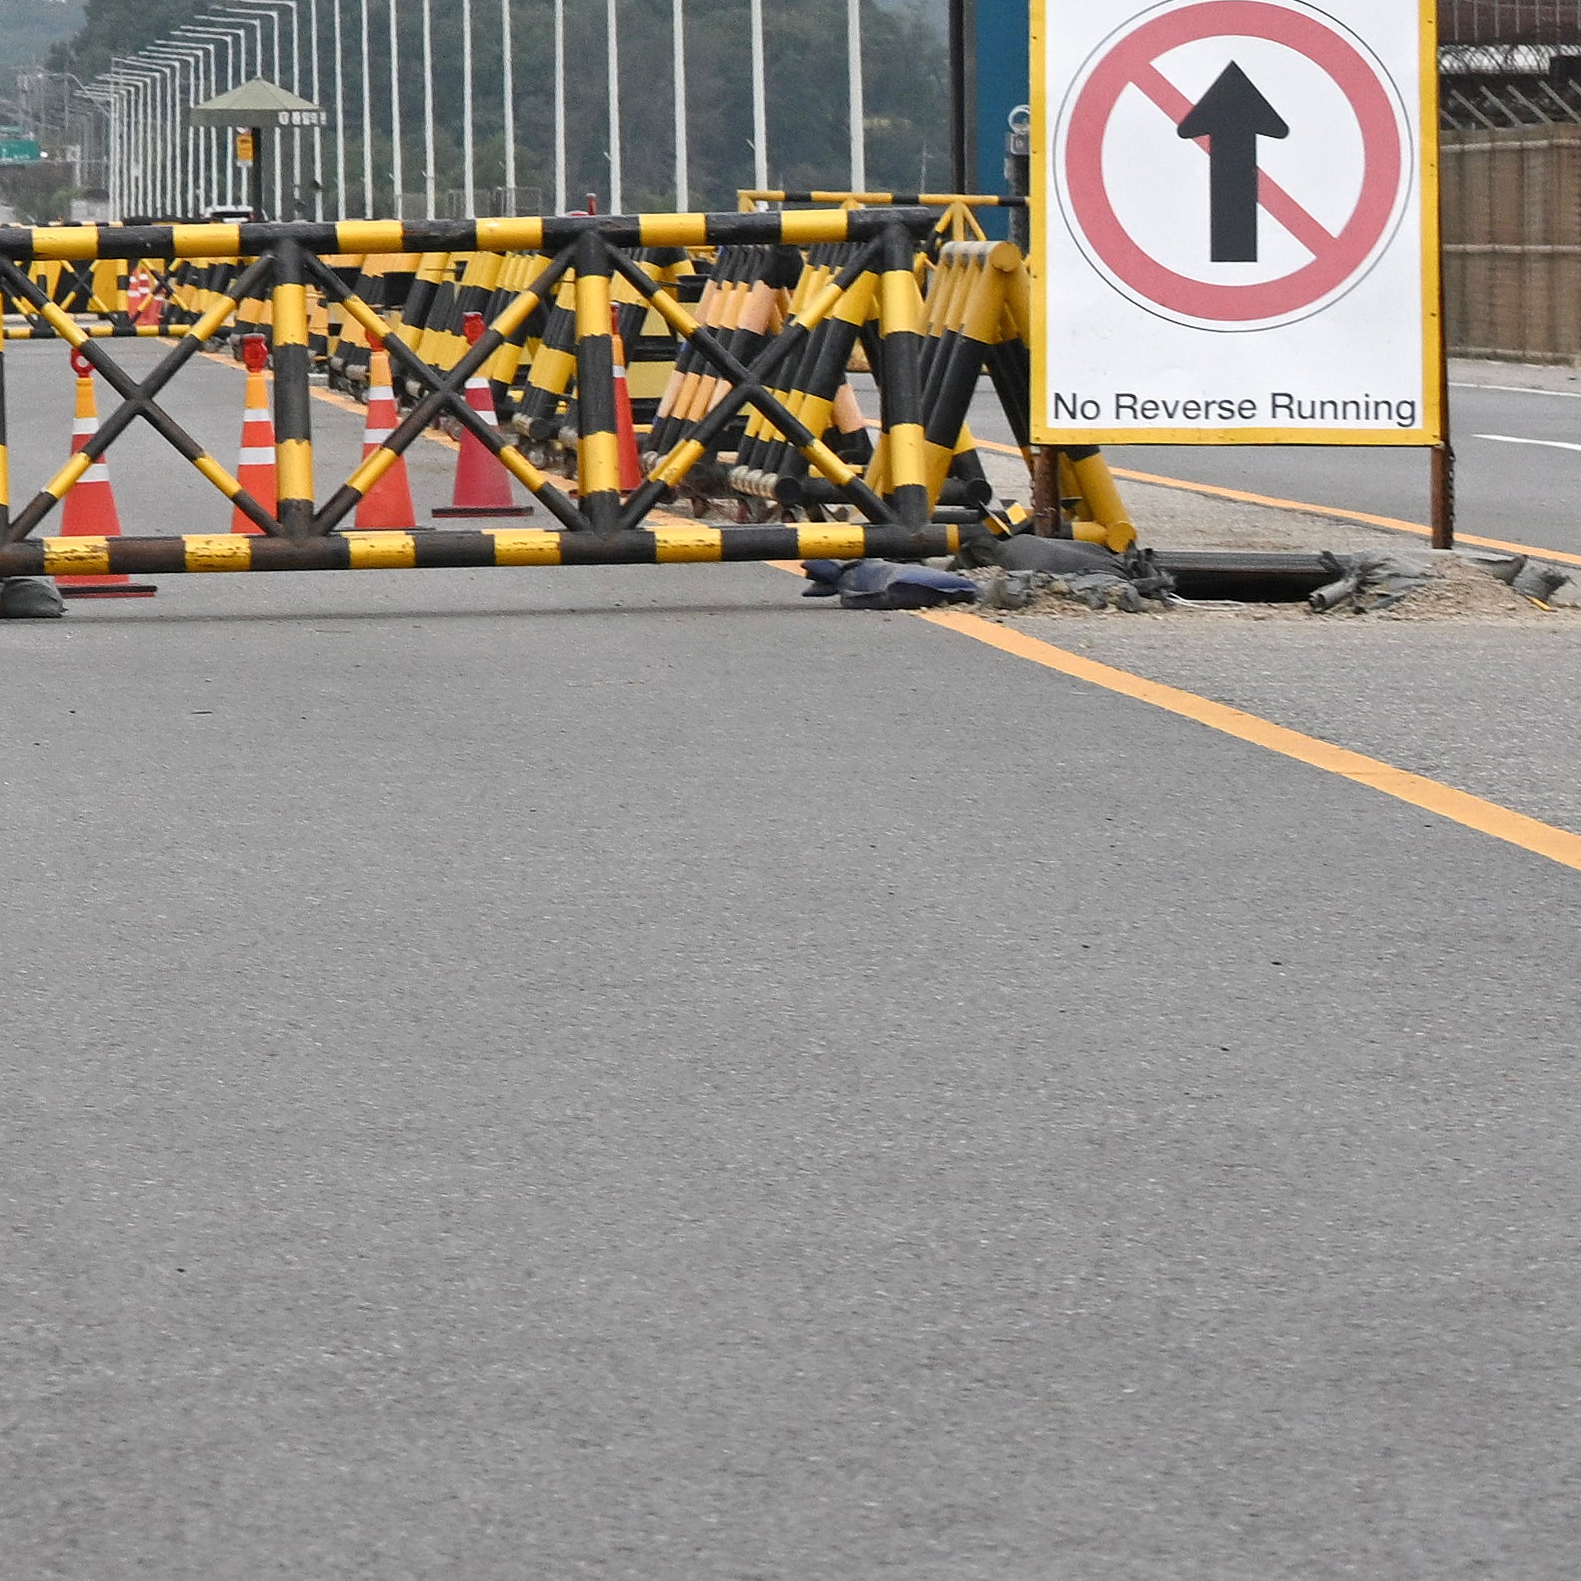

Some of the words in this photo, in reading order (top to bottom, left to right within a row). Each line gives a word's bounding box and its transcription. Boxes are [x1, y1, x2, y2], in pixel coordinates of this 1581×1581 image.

[1053, 392, 1102, 421] No
[1115, 392, 1258, 422] Reverse
[1271, 392, 1417, 430] Running
